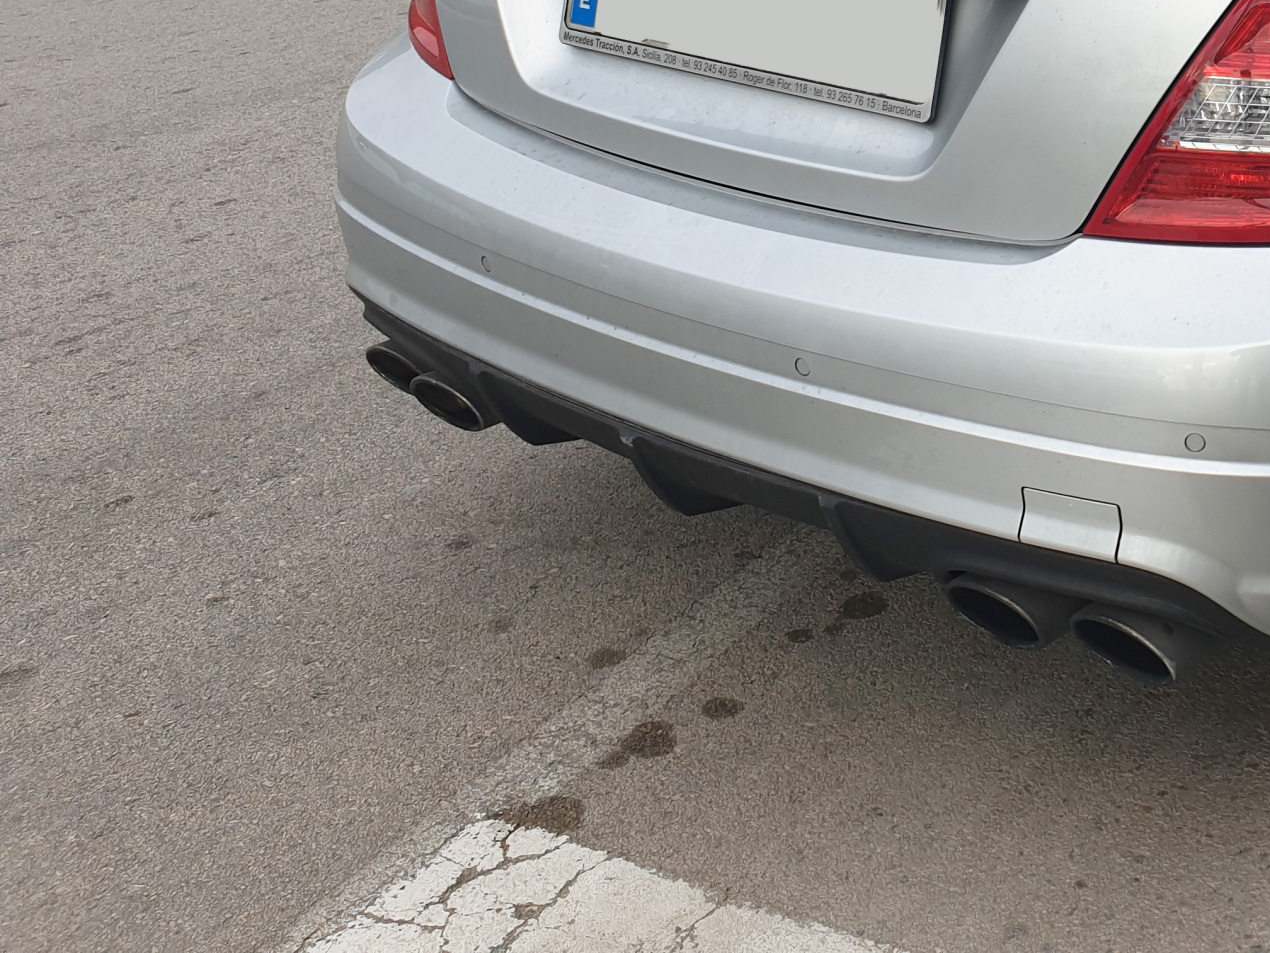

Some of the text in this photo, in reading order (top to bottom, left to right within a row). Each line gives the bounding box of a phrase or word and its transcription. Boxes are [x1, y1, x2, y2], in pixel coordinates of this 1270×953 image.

[563, 31, 594, 47] Mercedes
[595, 39, 625, 55] Tracción,
[626, 46, 640, 56] S.A.
[664, 53, 677, 65] 208
[682, 58, 692, 68] tel.
[694, 60, 702, 71] 93
[703, 62, 717, 74] 245
[718, 66, 727, 76] 40
[728, 68, 738, 78] 85
[743, 71, 765, 85] Roger
[766, 76, 775, 87] de
[795, 82, 808, 94] 118
[813, 87, 824, 98] tel.
[827, 89, 836, 100] 93
[838, 92, 852, 104] 265
[854, 95, 864, 106] 76
[867, 97, 876, 108] 15
[882, 100, 922, 119] Barcelona
